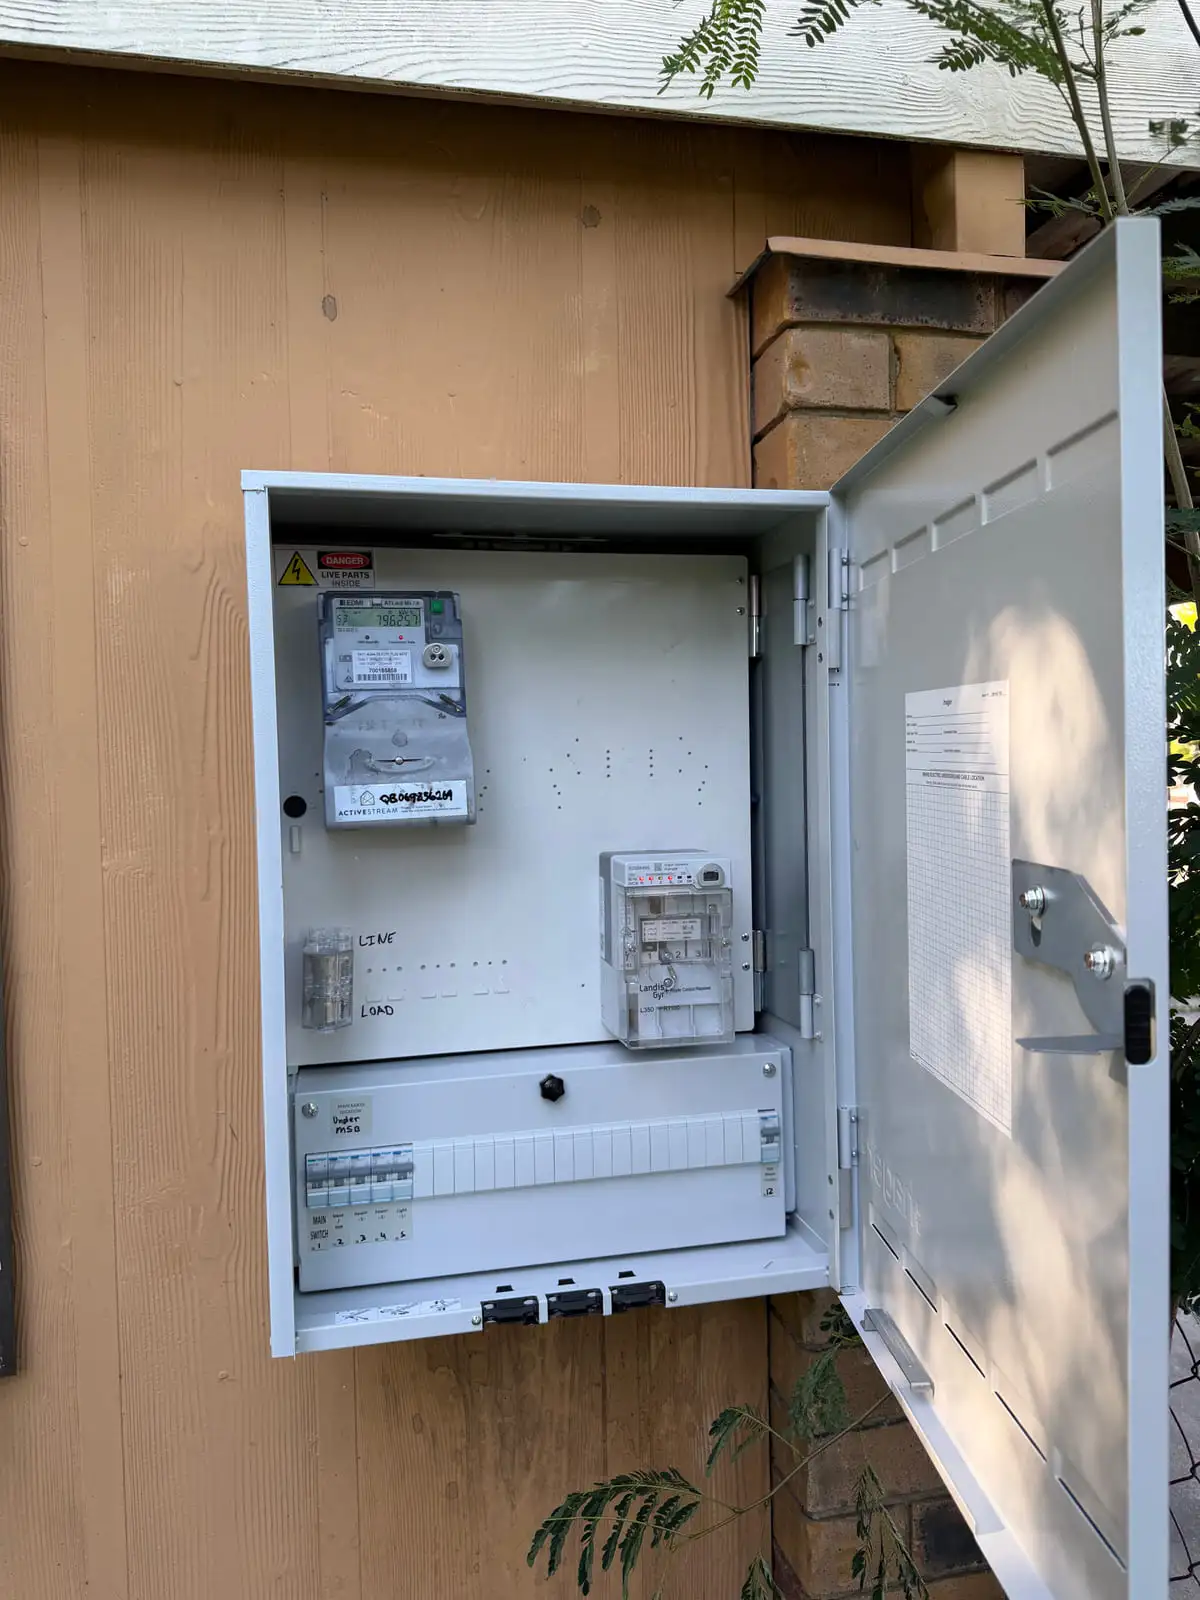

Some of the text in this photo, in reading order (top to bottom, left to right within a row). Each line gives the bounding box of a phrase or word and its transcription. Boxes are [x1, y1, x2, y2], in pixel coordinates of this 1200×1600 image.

[326, 557, 364, 565] DANGER
[321, 571, 370, 579] LIVE PARTS
[332, 580, 361, 588] INSIDE
[338, 807, 399, 817] ACTIVESTREAM
[359, 931, 397, 947] LINE
[639, 983, 665, 992] Landis
[361, 1004, 395, 1018] LOAD
[333, 1115, 361, 1125] Under
[312, 1215, 327, 1225] MAIN
[310, 1229, 329, 1240] SWITCH
[380, 1231, 387, 1240] 4
